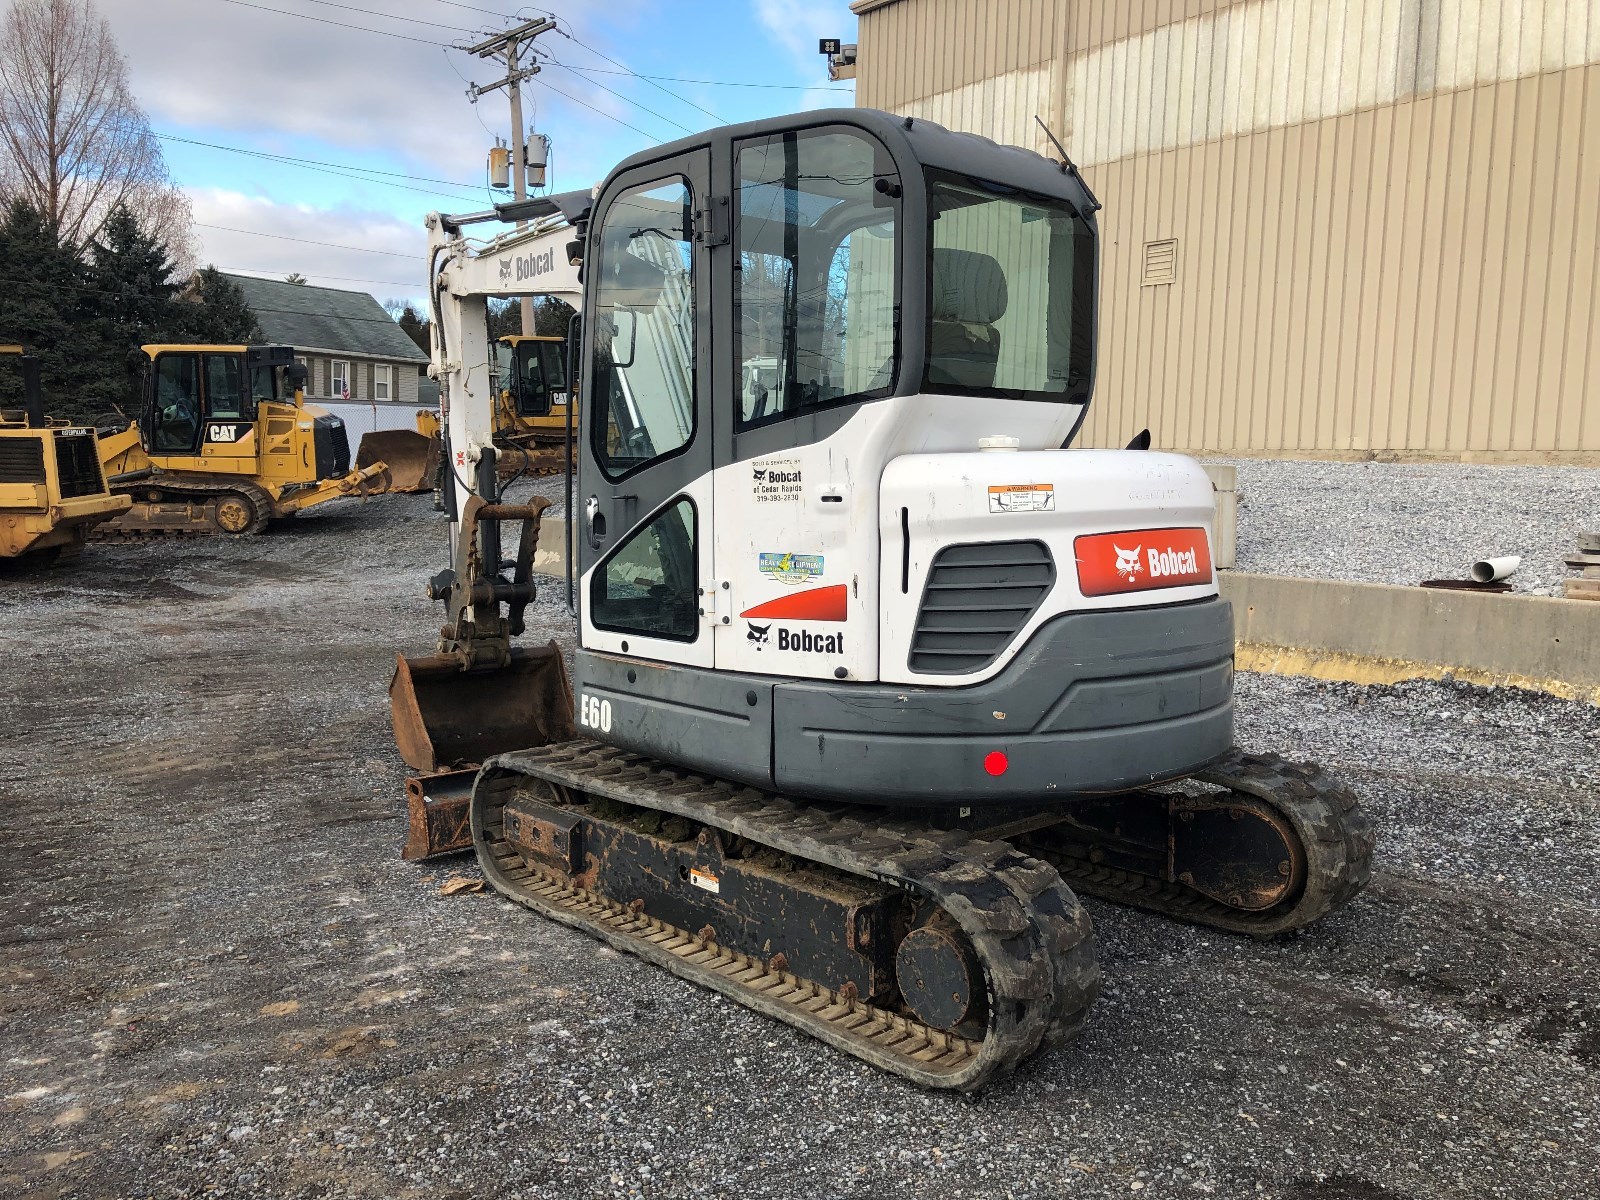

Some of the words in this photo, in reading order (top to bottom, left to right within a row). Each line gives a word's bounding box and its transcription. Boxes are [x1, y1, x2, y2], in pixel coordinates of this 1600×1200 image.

[516, 247, 554, 281] Bobcat
[553, 392, 567, 404] CAT
[210, 425, 237, 441] CAT
[769, 470, 802, 483] Bobcat
[753, 485, 760, 493] of
[762, 485, 779, 493] Cedar
[782, 483, 802, 493] Rapids
[788, 561, 822, 569] EUIPMENT
[1146, 546, 1198, 577] Bobcat
[778, 627, 844, 654] Bobcat
[581, 693, 612, 733] E60
